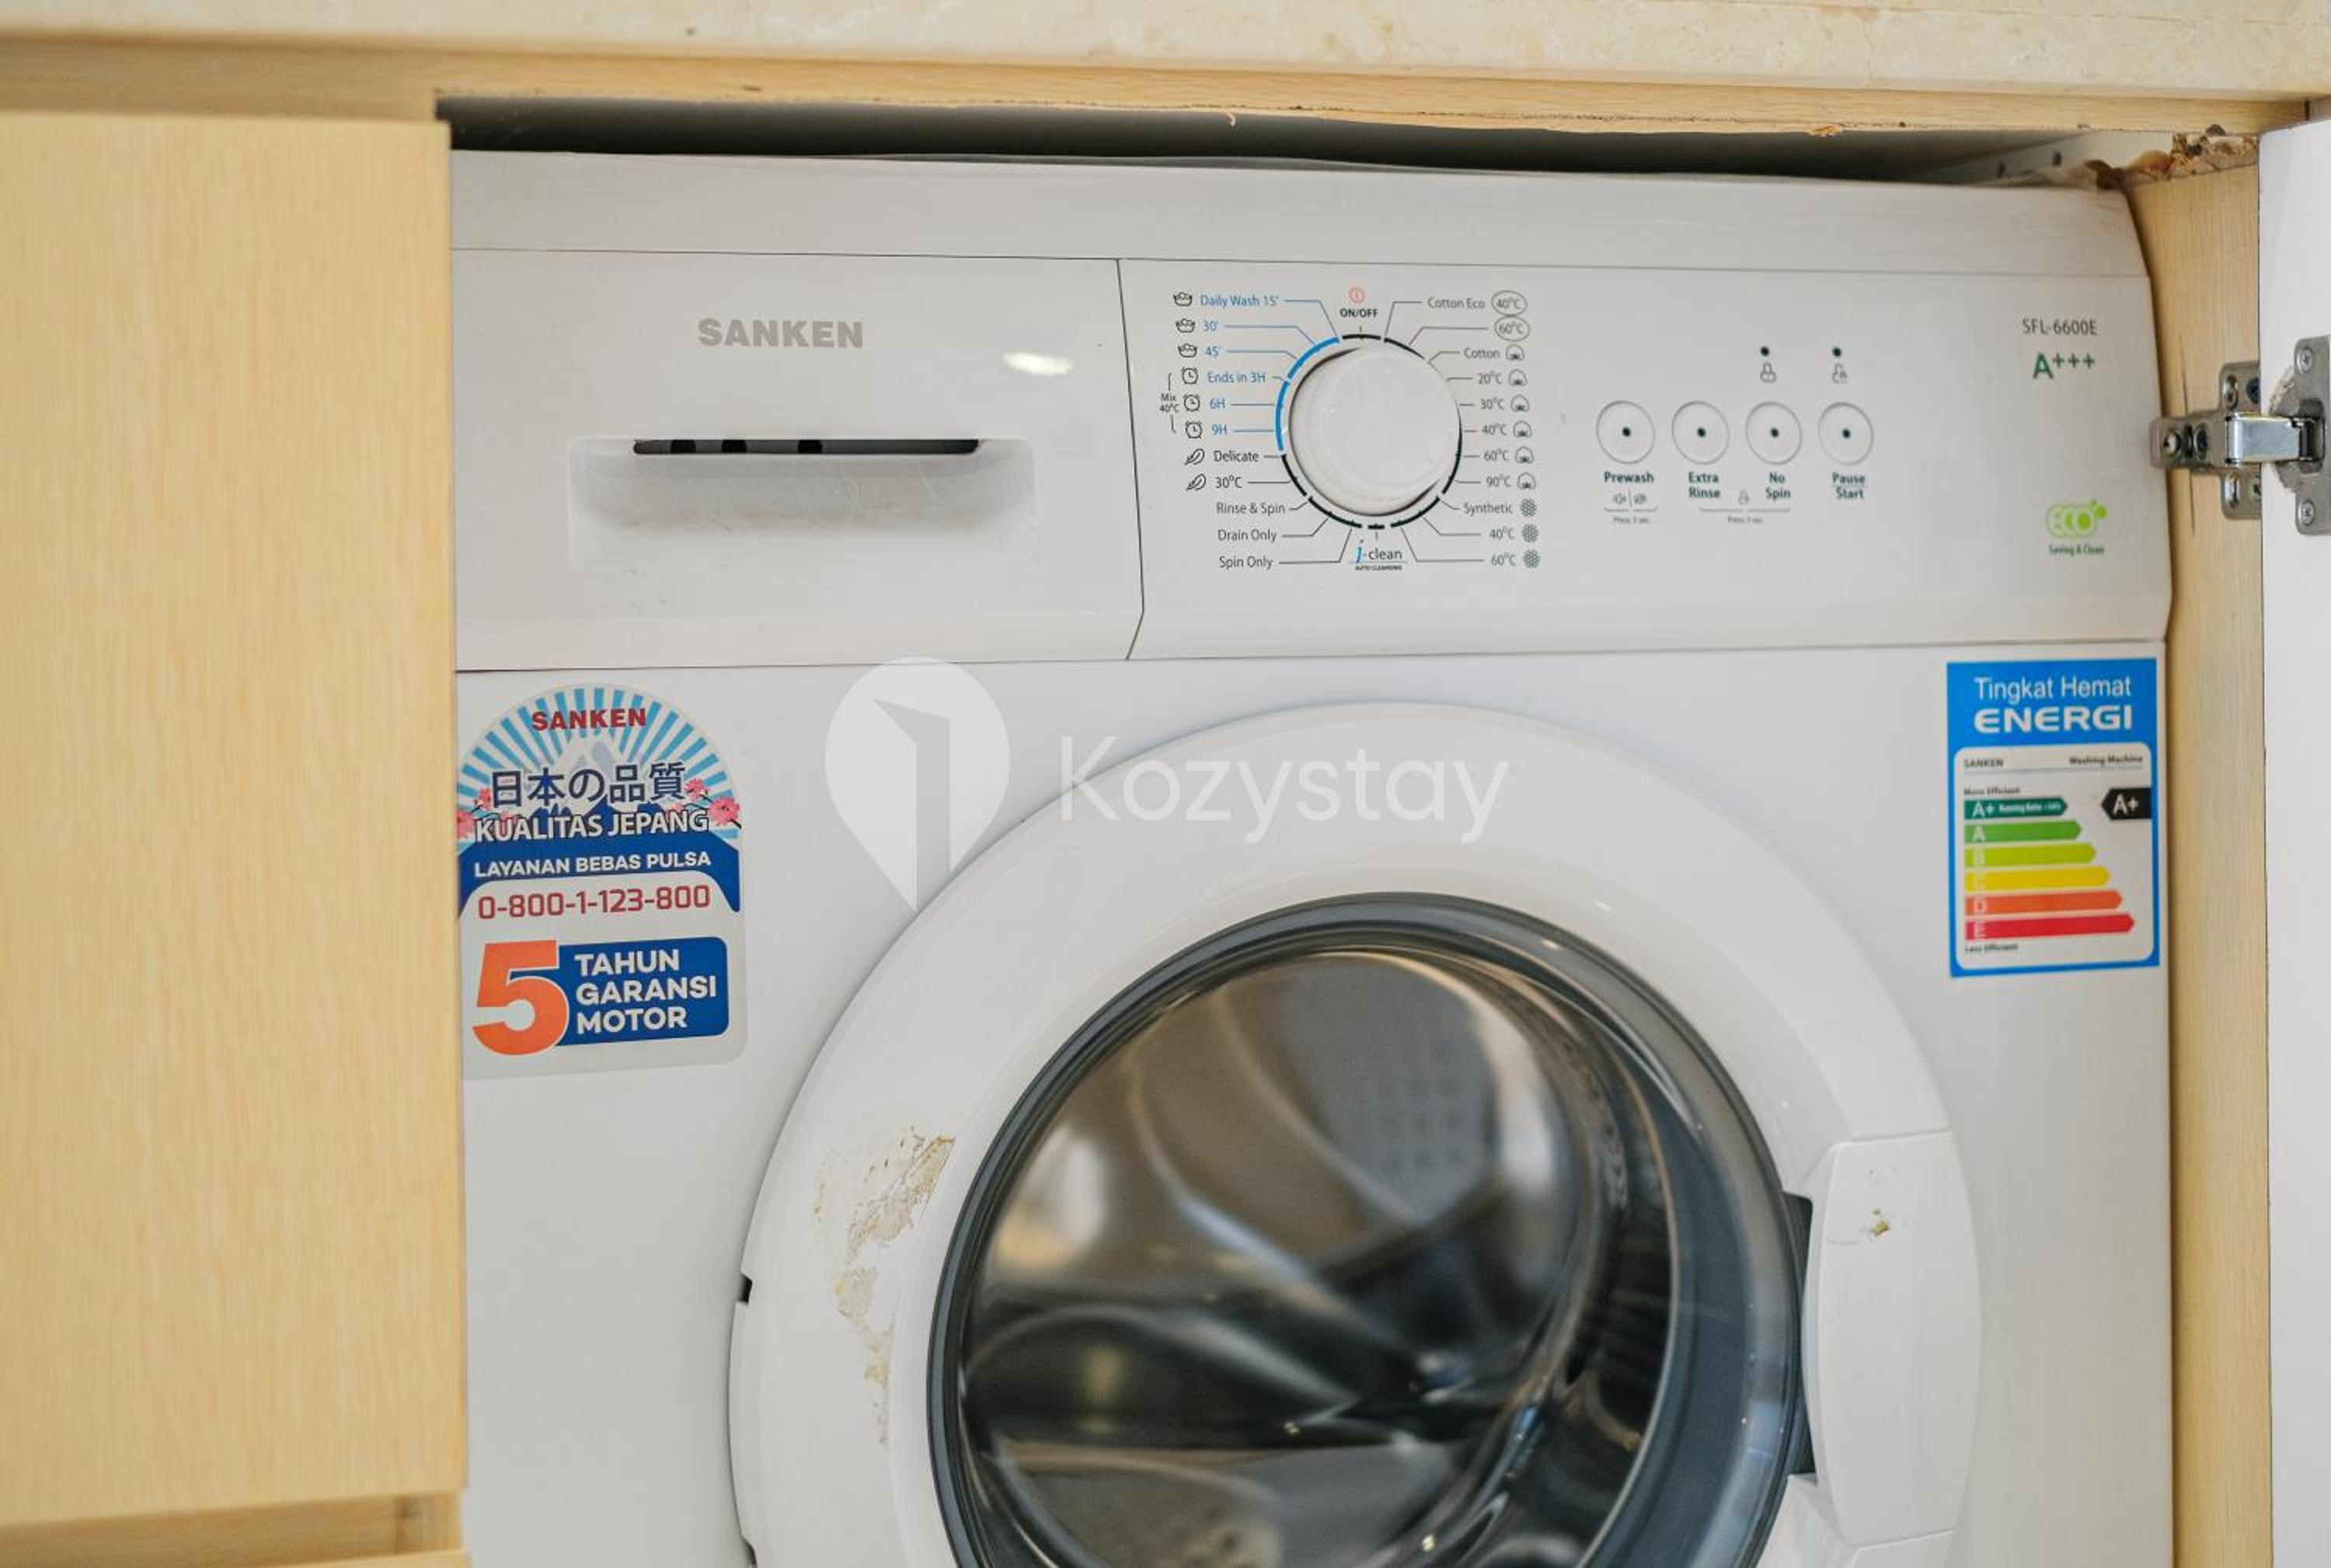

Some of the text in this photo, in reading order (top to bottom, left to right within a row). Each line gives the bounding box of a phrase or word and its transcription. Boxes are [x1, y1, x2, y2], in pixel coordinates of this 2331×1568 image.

[1200, 294, 1228, 309] Daily
[1228, 294, 1260, 306] Wash
[1427, 298, 1465, 309] Cotton
[1466, 298, 1485, 309] Eco
[1340, 308, 1378, 318] ON/OFF
[698, 318, 863, 349] SANKEN
[2023, 318, 2098, 336] SFL-6600E
[1464, 347, 1500, 359] Cotton
[2033, 352, 2096, 379] A+++
[1207, 371, 1266, 383] Ends in 3H
[1210, 399, 1225, 409] 6H
[1211, 424, 1228, 435] 9H
[1213, 450, 1260, 462] Delicate
[1603, 472, 1654, 483] Prewash
[1688, 472, 1719, 483] Extra
[1768, 472, 1786, 484] No
[1832, 472, 1866, 484] Pause
[1688, 486, 1721, 499] Rinse
[1765, 486, 1791, 502] Spin
[1835, 486, 1865, 500] Start
[1216, 502, 1286, 516] Rinse & Spin
[1464, 501, 1513, 516] Synthetic
[1218, 528, 1277, 545] Drain Only
[2049, 543, 2075, 556] Saving
[2082, 543, 2105, 554] Clean
[1219, 555, 1273, 570] Spin Only
[1973, 675, 2131, 706] Tingkat Hemat
[532, 709, 646, 730] SANKEN
[1974, 705, 2133, 733] ENERGI
[1963, 754, 2143, 768] SANKEN Washing Machine
[491, 761, 686, 808] 日本の品質
[1972, 800, 1995, 819] A+
[2113, 793, 2140, 815] A+
[475, 808, 709, 843] KUALITAS JEPANG
[1973, 825, 1986, 843] A
[475, 851, 712, 878] LAYANAN BEBAS PULSA
[478, 884, 711, 920] 0-800-1-123-800
[574, 949, 680, 977] TAHUN
[472, 939, 570, 1056] 5
[576, 975, 717, 1006] GARANSI
[577, 1006, 687, 1035] MOTOR
